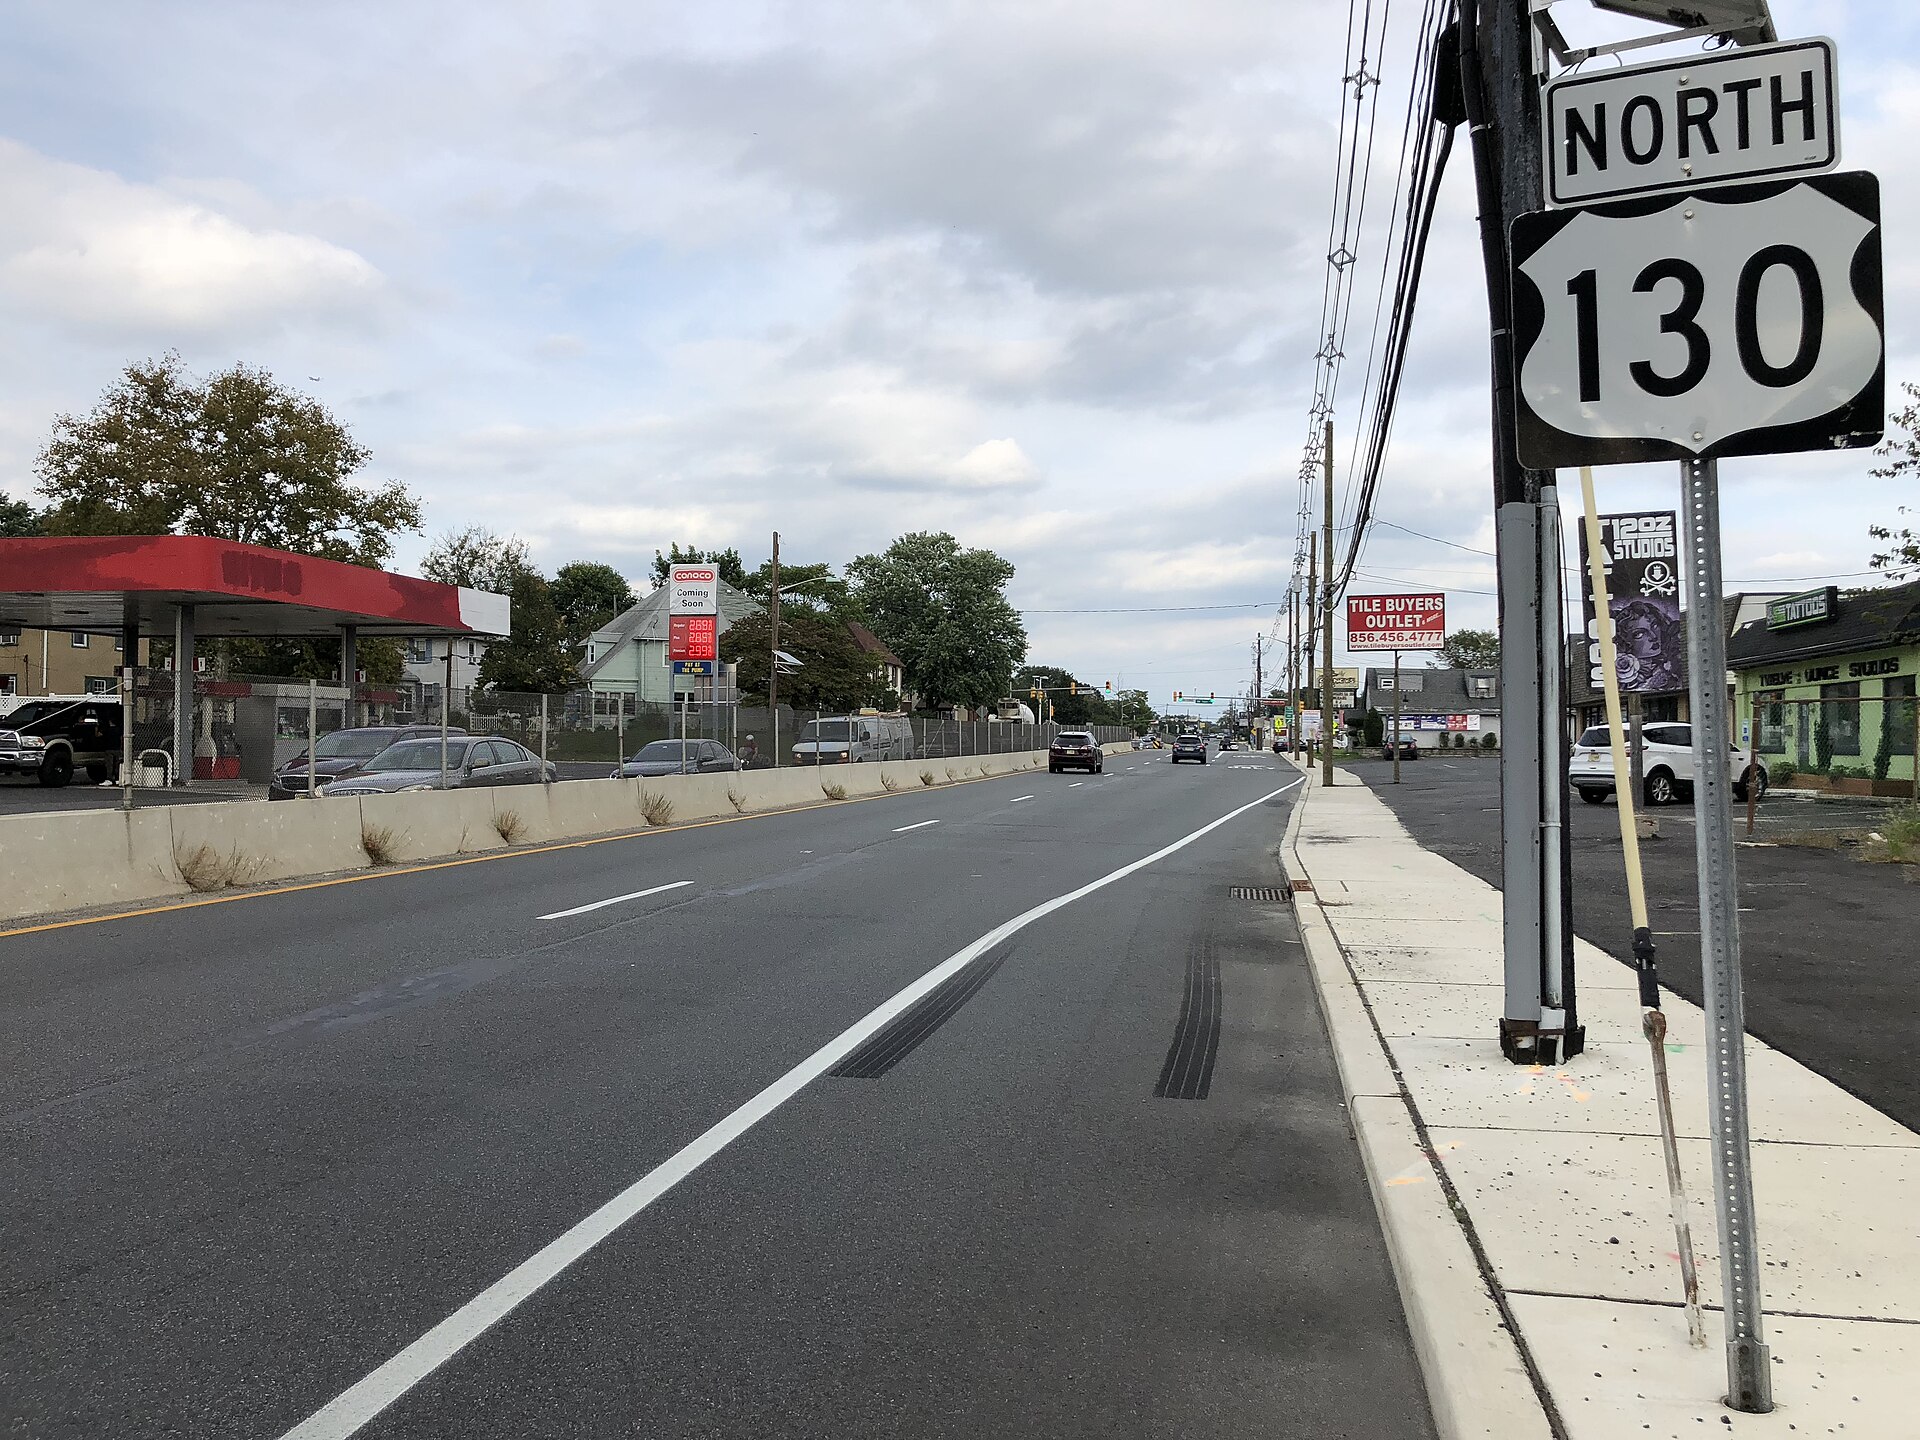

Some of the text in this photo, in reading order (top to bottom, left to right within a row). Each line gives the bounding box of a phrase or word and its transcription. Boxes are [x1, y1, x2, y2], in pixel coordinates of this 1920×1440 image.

[1565, 70, 1816, 177] NORTH
[1566, 243, 1825, 403] 130
[1613, 537, 1675, 560] STUDIOS
[677, 588, 709, 599] Coming
[681, 599, 704, 607] Soon
[1349, 597, 1444, 613] TILE BUYERS
[1785, 594, 1826, 622] TATTOOS
[1365, 614, 1423, 628] OUTLET
[1350, 632, 1442, 642] 856.456.4777
[1759, 671, 1793, 687] TWELVE
[1848, 657, 1899, 677] STUDIOS
